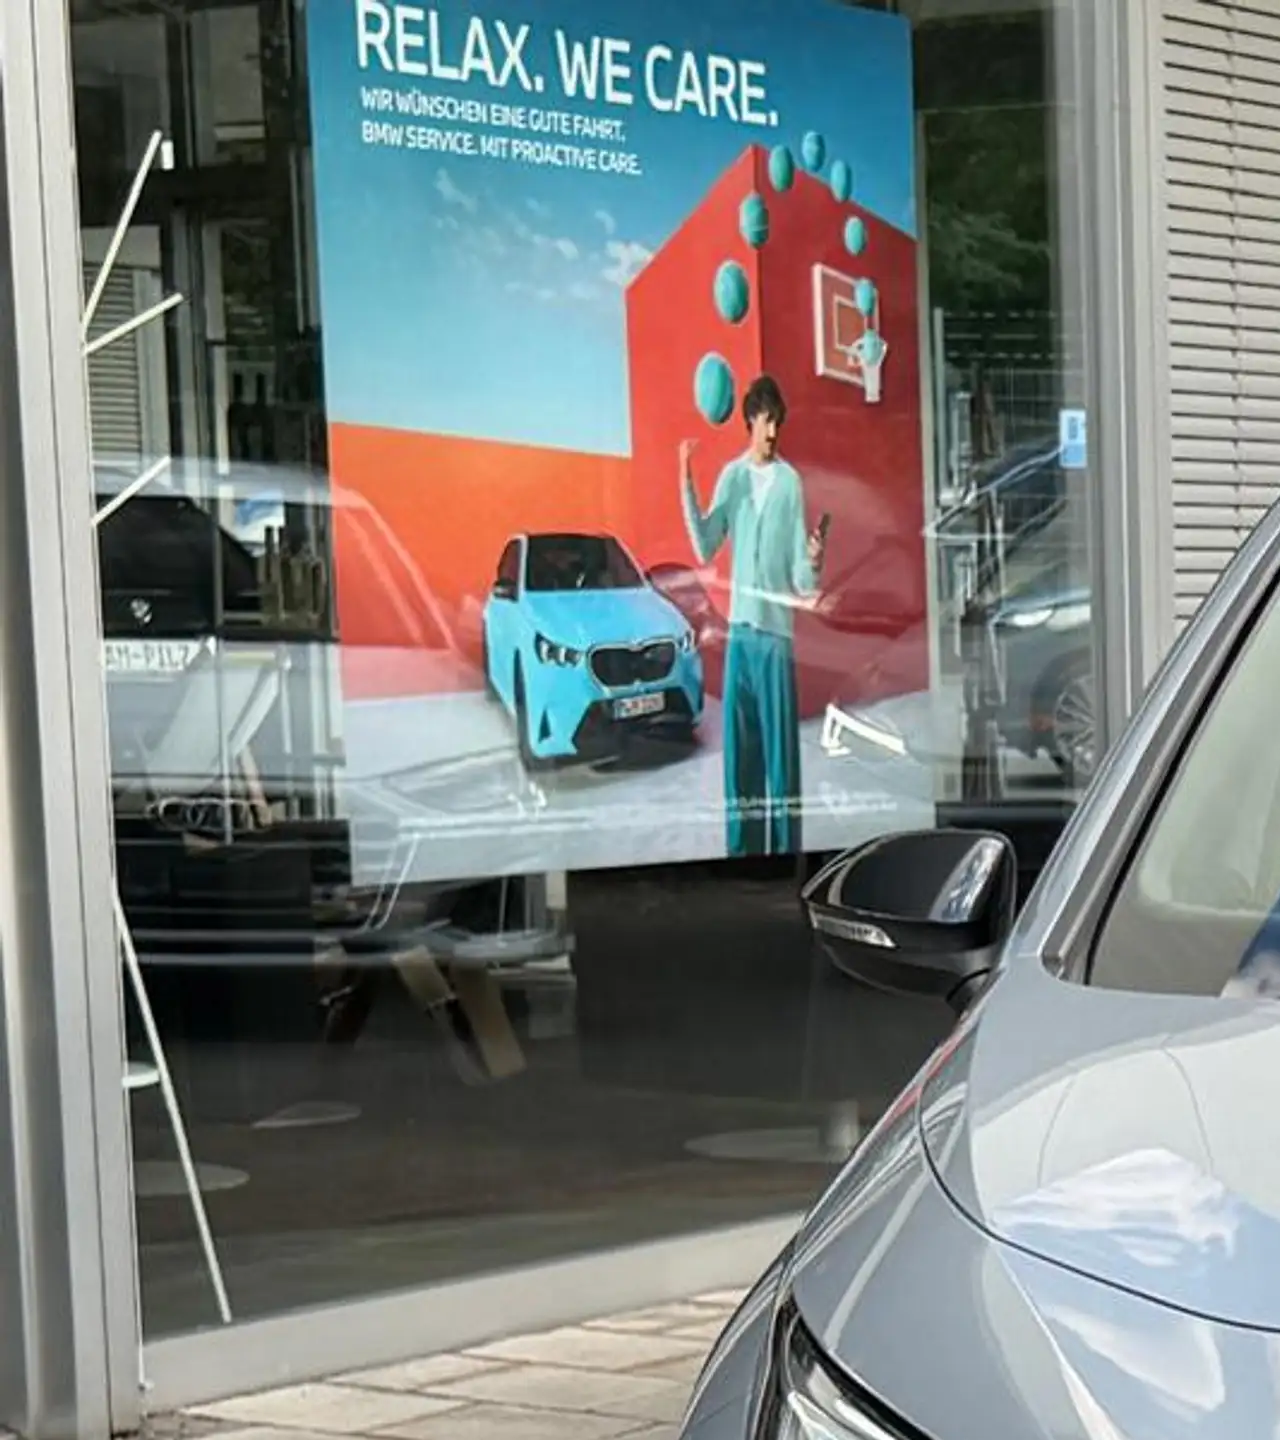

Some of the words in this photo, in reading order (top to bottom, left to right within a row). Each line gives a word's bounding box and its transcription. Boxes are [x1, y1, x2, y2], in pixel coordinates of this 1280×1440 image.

[356, 0, 544, 92] RELAX.
[555, 28, 634, 105] WE
[645, 44, 779, 127] CARE.
[361, 86, 393, 111] WIR
[395, 87, 488, 124] WÜNSCHEN
[490, 103, 527, 129] EINE
[528, 108, 571, 135] GUTE
[362, 120, 403, 146] BMW
[480, 135, 510, 160] MIT
[511, 138, 597, 171] PROACTIVE
